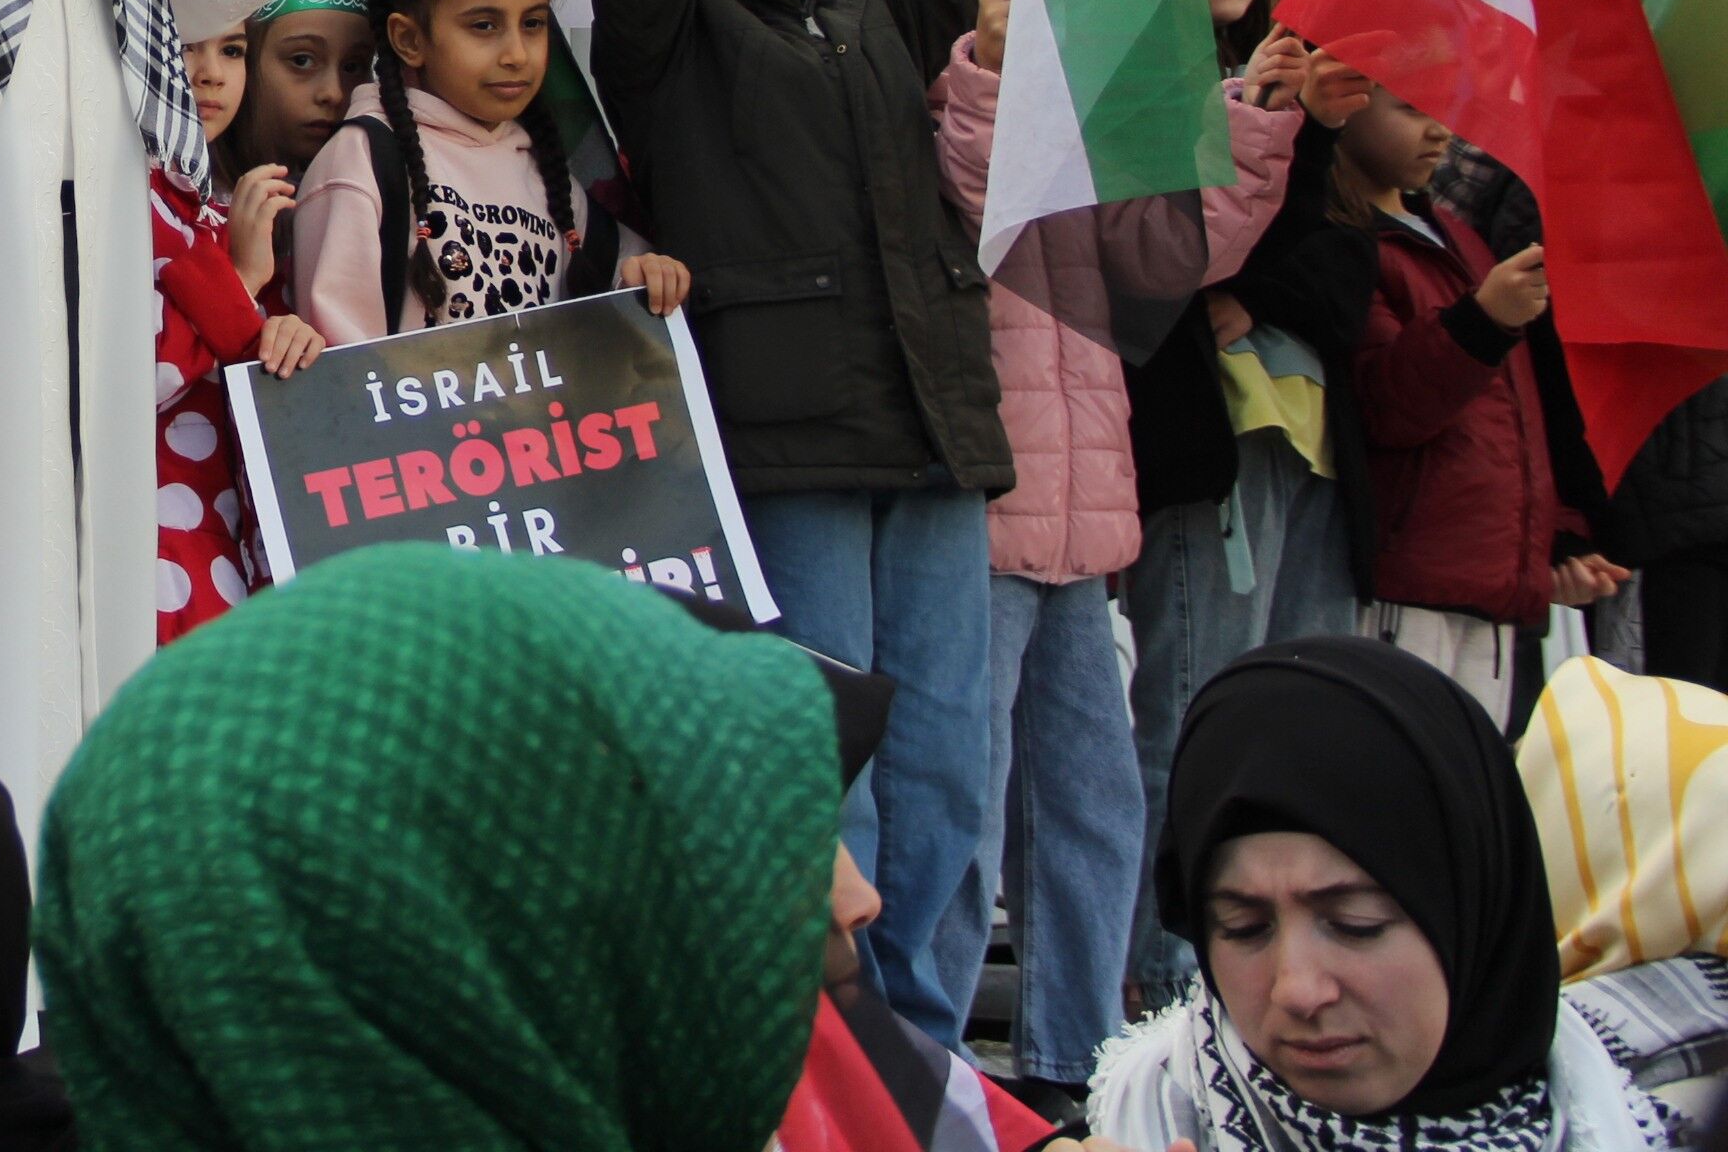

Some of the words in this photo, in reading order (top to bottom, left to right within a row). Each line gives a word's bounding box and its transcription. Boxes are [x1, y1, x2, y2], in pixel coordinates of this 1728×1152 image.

[472, 203, 555, 241] GROWING
[365, 342, 564, 424] İSRAİL
[304, 401, 662, 529] TERÖRİST
[446, 500, 564, 557] BİR
[609, 546, 724, 601] İR!
